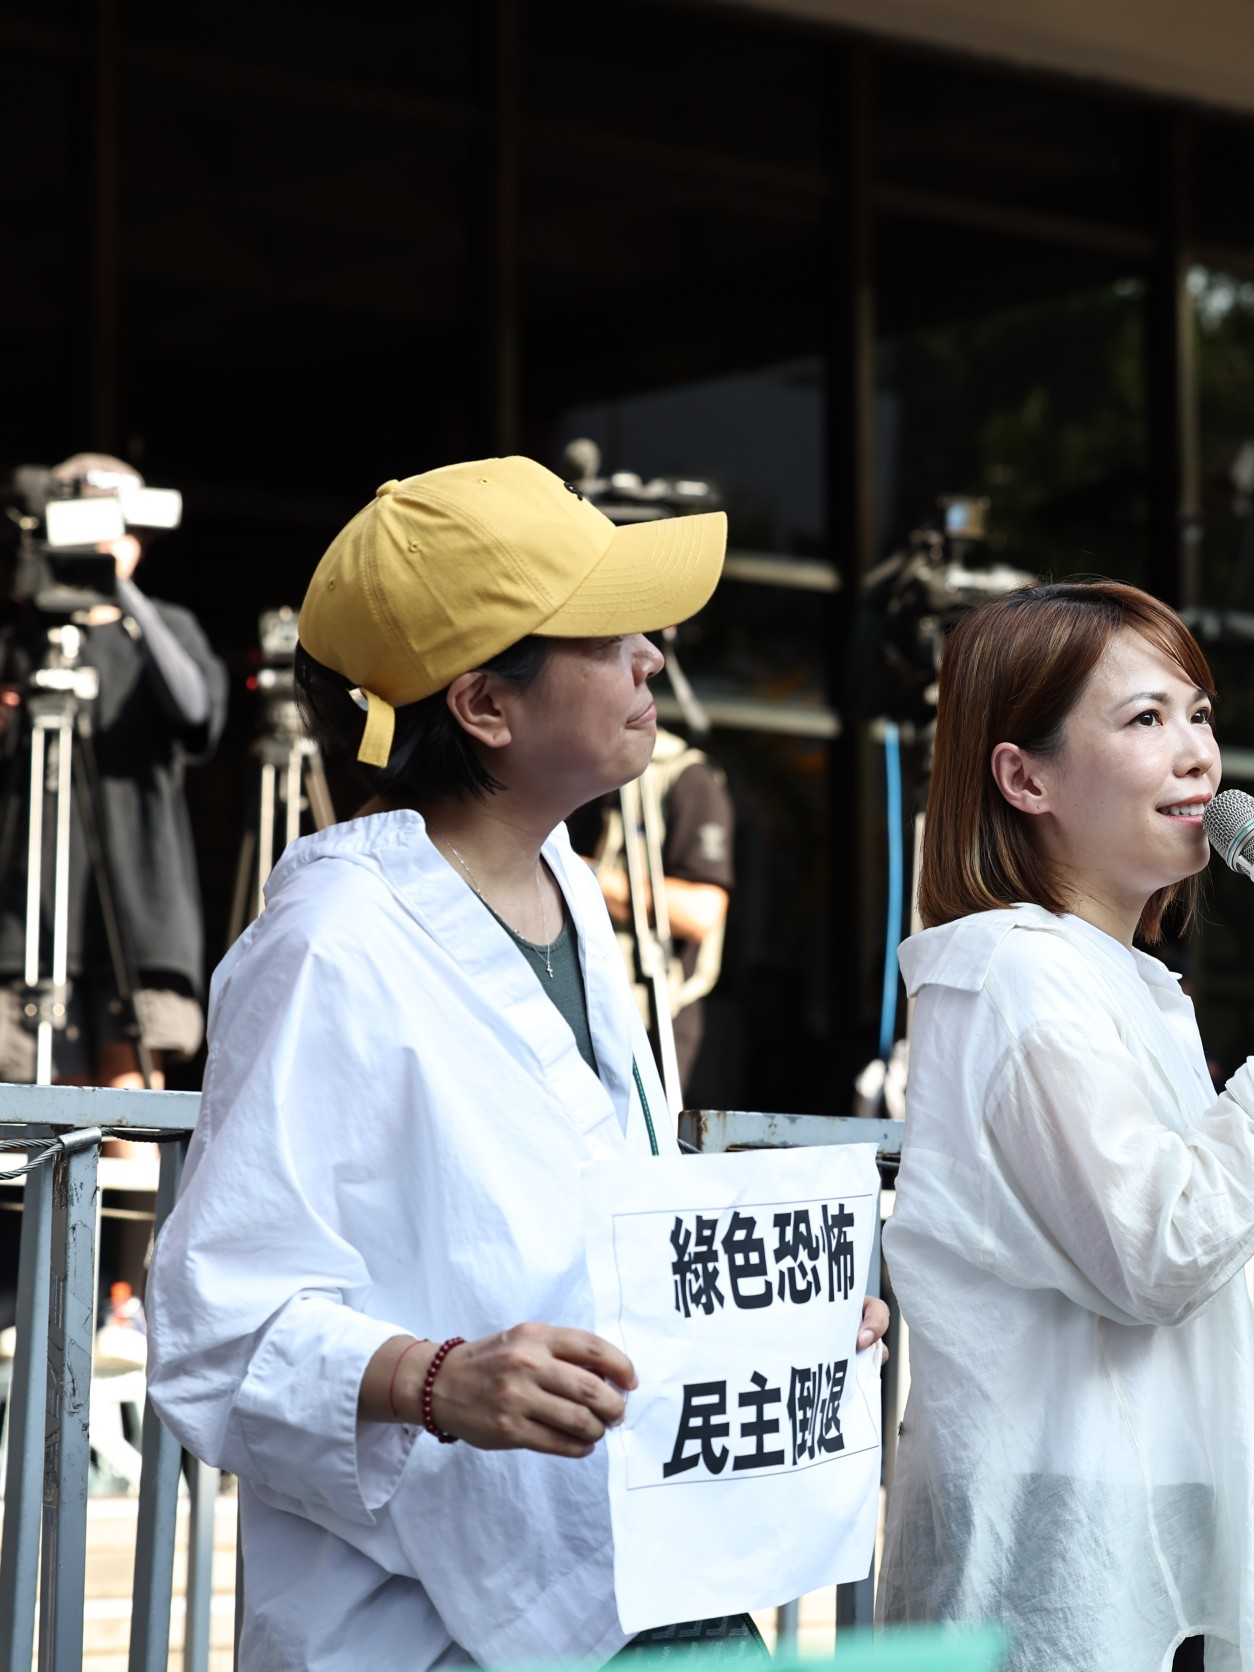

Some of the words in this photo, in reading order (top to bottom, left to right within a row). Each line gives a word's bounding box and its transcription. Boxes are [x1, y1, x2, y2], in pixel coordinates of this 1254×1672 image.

[670, 1203, 855, 1318] 綠色恐怖
[663, 1359, 848, 1479] 民主倒退
